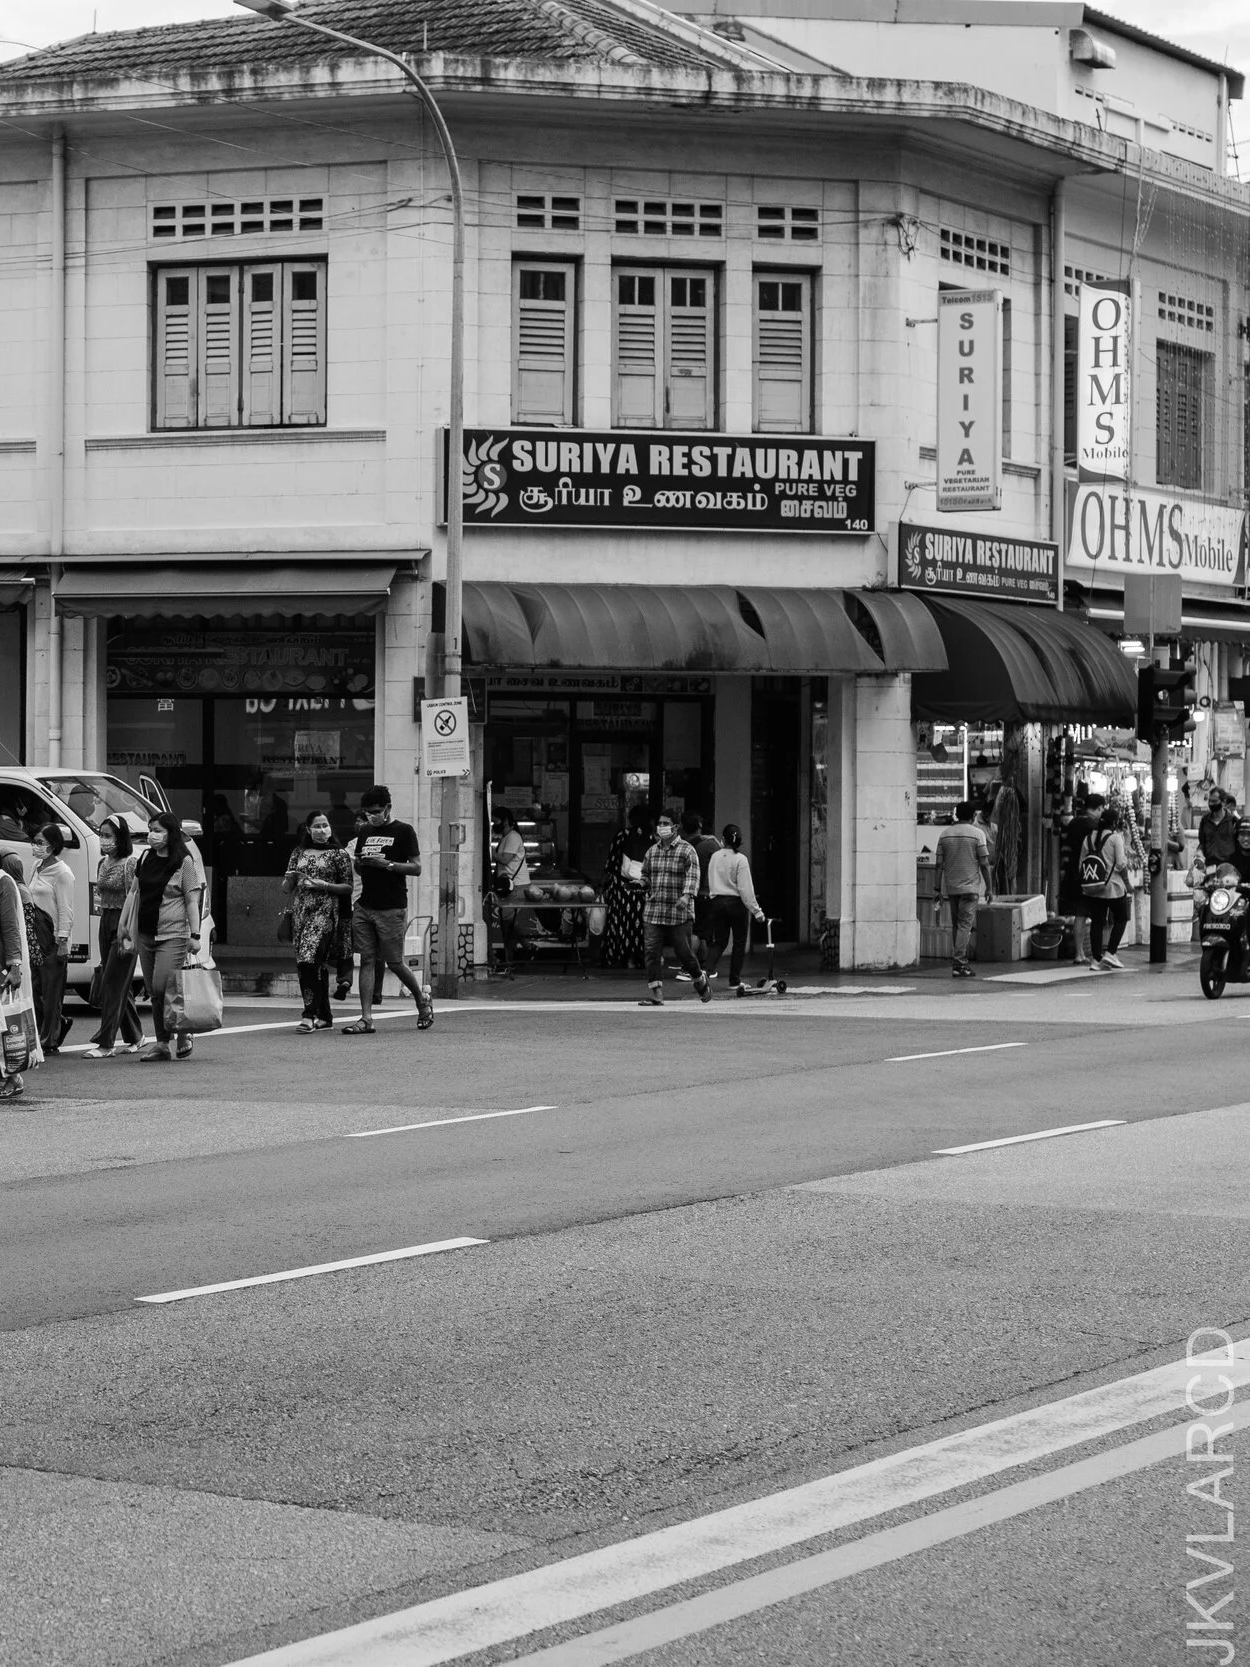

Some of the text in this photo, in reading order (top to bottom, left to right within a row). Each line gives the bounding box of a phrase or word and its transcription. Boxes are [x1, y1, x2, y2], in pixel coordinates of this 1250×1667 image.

[1087, 297, 1126, 445] OHMS
[957, 312, 976, 466] SURIYA
[511, 438, 863, 481] SURIYA RESTAURANT
[1082, 446, 1129, 460] Mobile
[942, 476, 990, 485] VEGETARIAN
[956, 469, 976, 477] PURE
[519, 476, 769, 514] சூரியா உணவகம்
[774, 482, 857, 497] PURE VEG
[942, 485, 990, 493] RESTAURANT
[844, 518, 869, 531] 140
[1080, 490, 1234, 572] OHMS Mobile
[925, 532, 1055, 575] SURIYA RESTAURANT
[1001, 576, 1028, 589] PURE VEG
